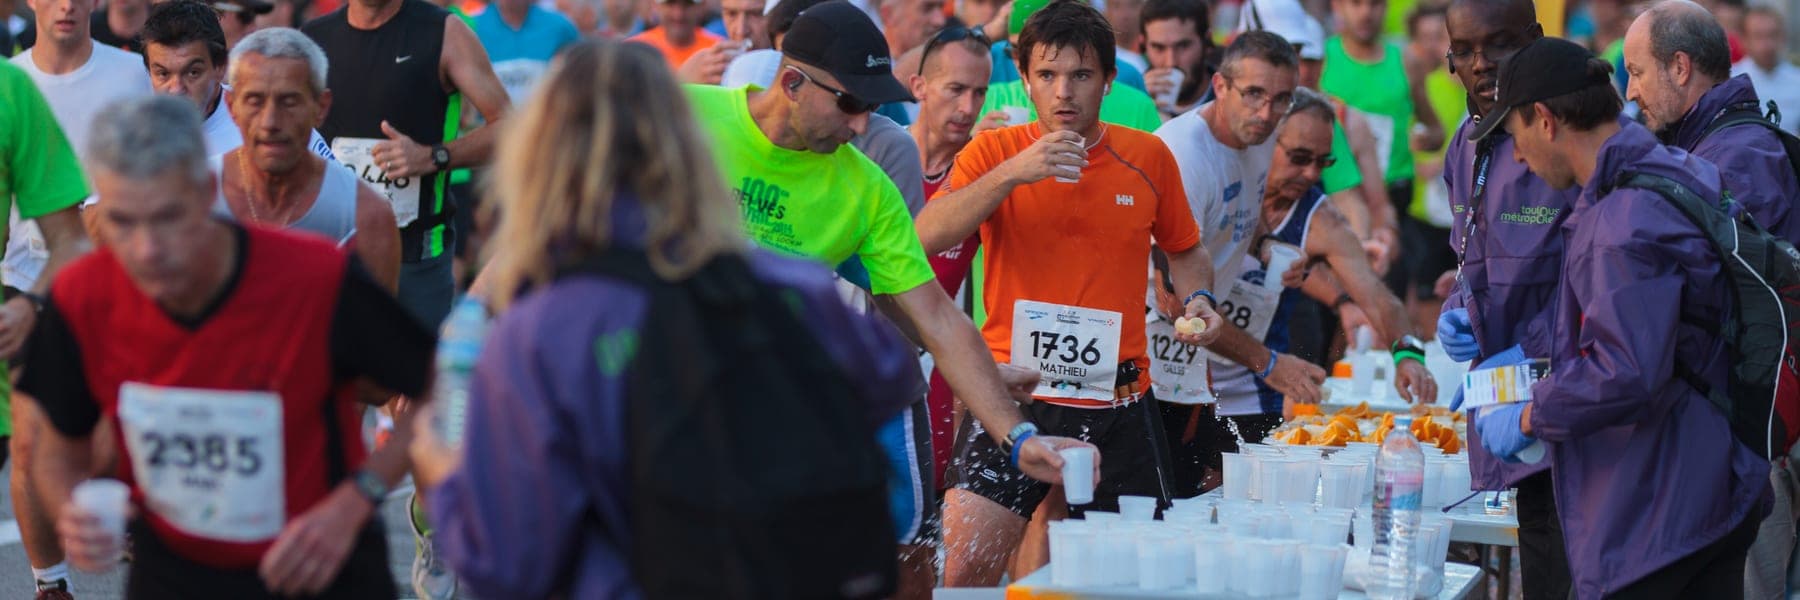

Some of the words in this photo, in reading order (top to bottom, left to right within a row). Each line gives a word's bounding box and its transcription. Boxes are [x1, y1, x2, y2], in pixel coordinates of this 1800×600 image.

[1030, 330, 1102, 366] 1736
[1152, 333, 1198, 365] 1229
[1040, 361, 1088, 378] MATHIEU
[141, 430, 264, 478] 2385
